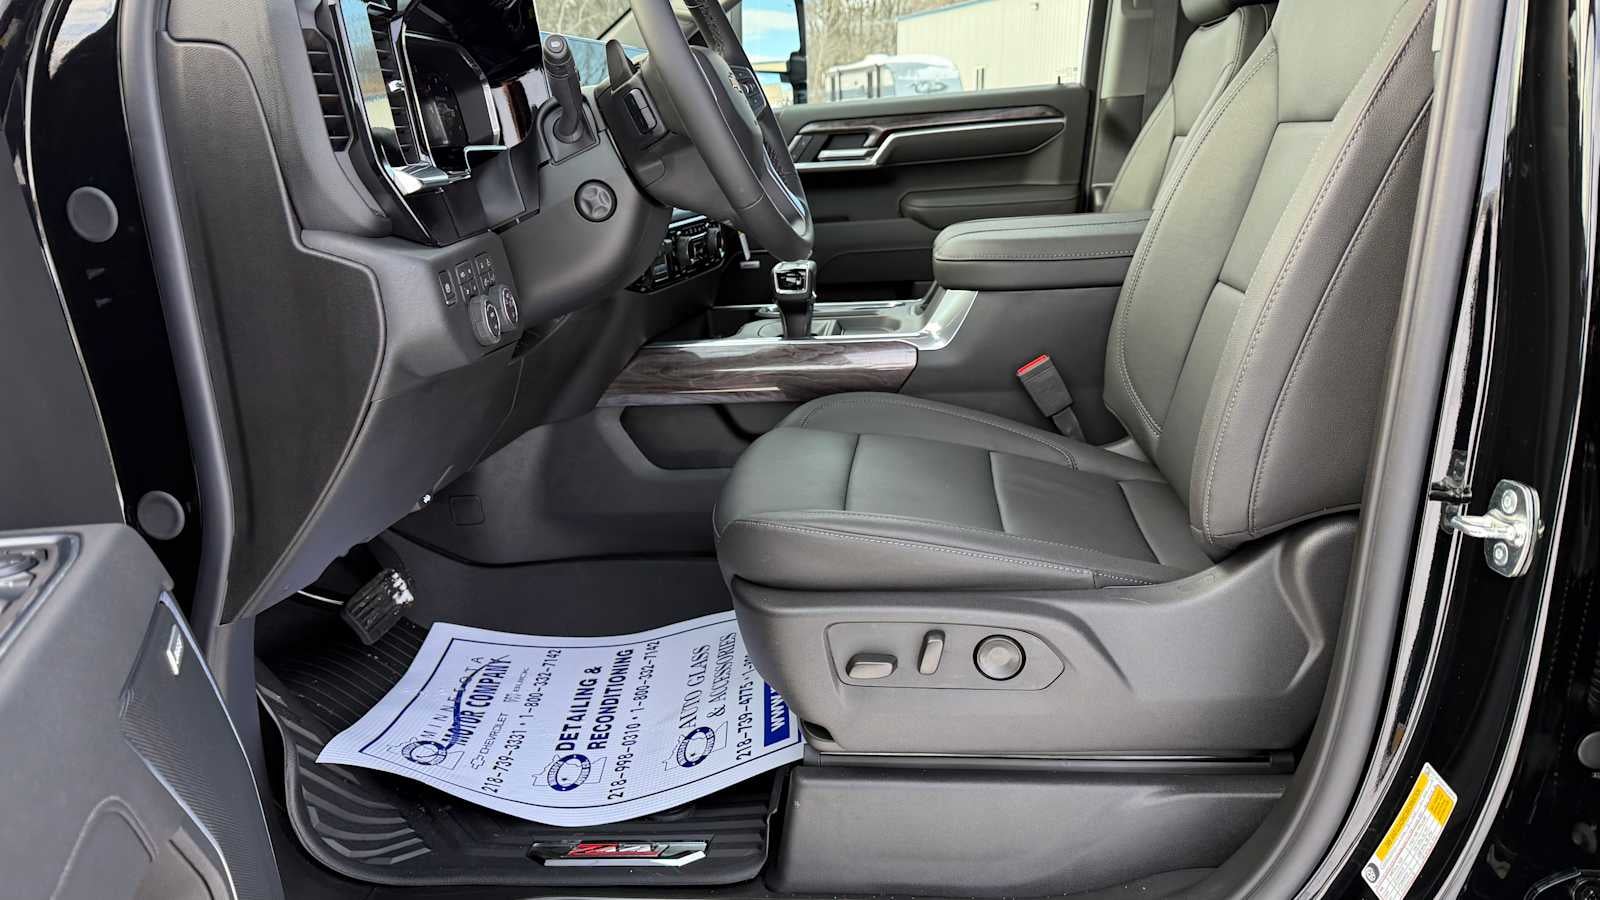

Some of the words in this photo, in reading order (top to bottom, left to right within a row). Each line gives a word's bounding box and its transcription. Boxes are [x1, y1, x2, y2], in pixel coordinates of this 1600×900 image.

[440, 710, 486, 747] MOTOR
[464, 656, 511, 708] COMPANY
[587, 648, 634, 750] RECONDITIONING
[686, 644, 710, 687] GLASS
[708, 632, 737, 703] ACCESSORIES
[480, 712, 508, 756] CHEVROLET
[481, 730, 527, 794] 218-739-3331
[518, 649, 561, 718] 1-800-332-7142
[555, 678, 598, 751] DETAILING
[584, 665, 602, 674] &
[608, 722, 641, 800] 218-998-0310
[630, 640, 660, 713] 1-800-332-7142
[679, 689, 703, 728] AUTO
[706, 704, 726, 718] &
[736, 681, 753, 761] 218-739-4775
